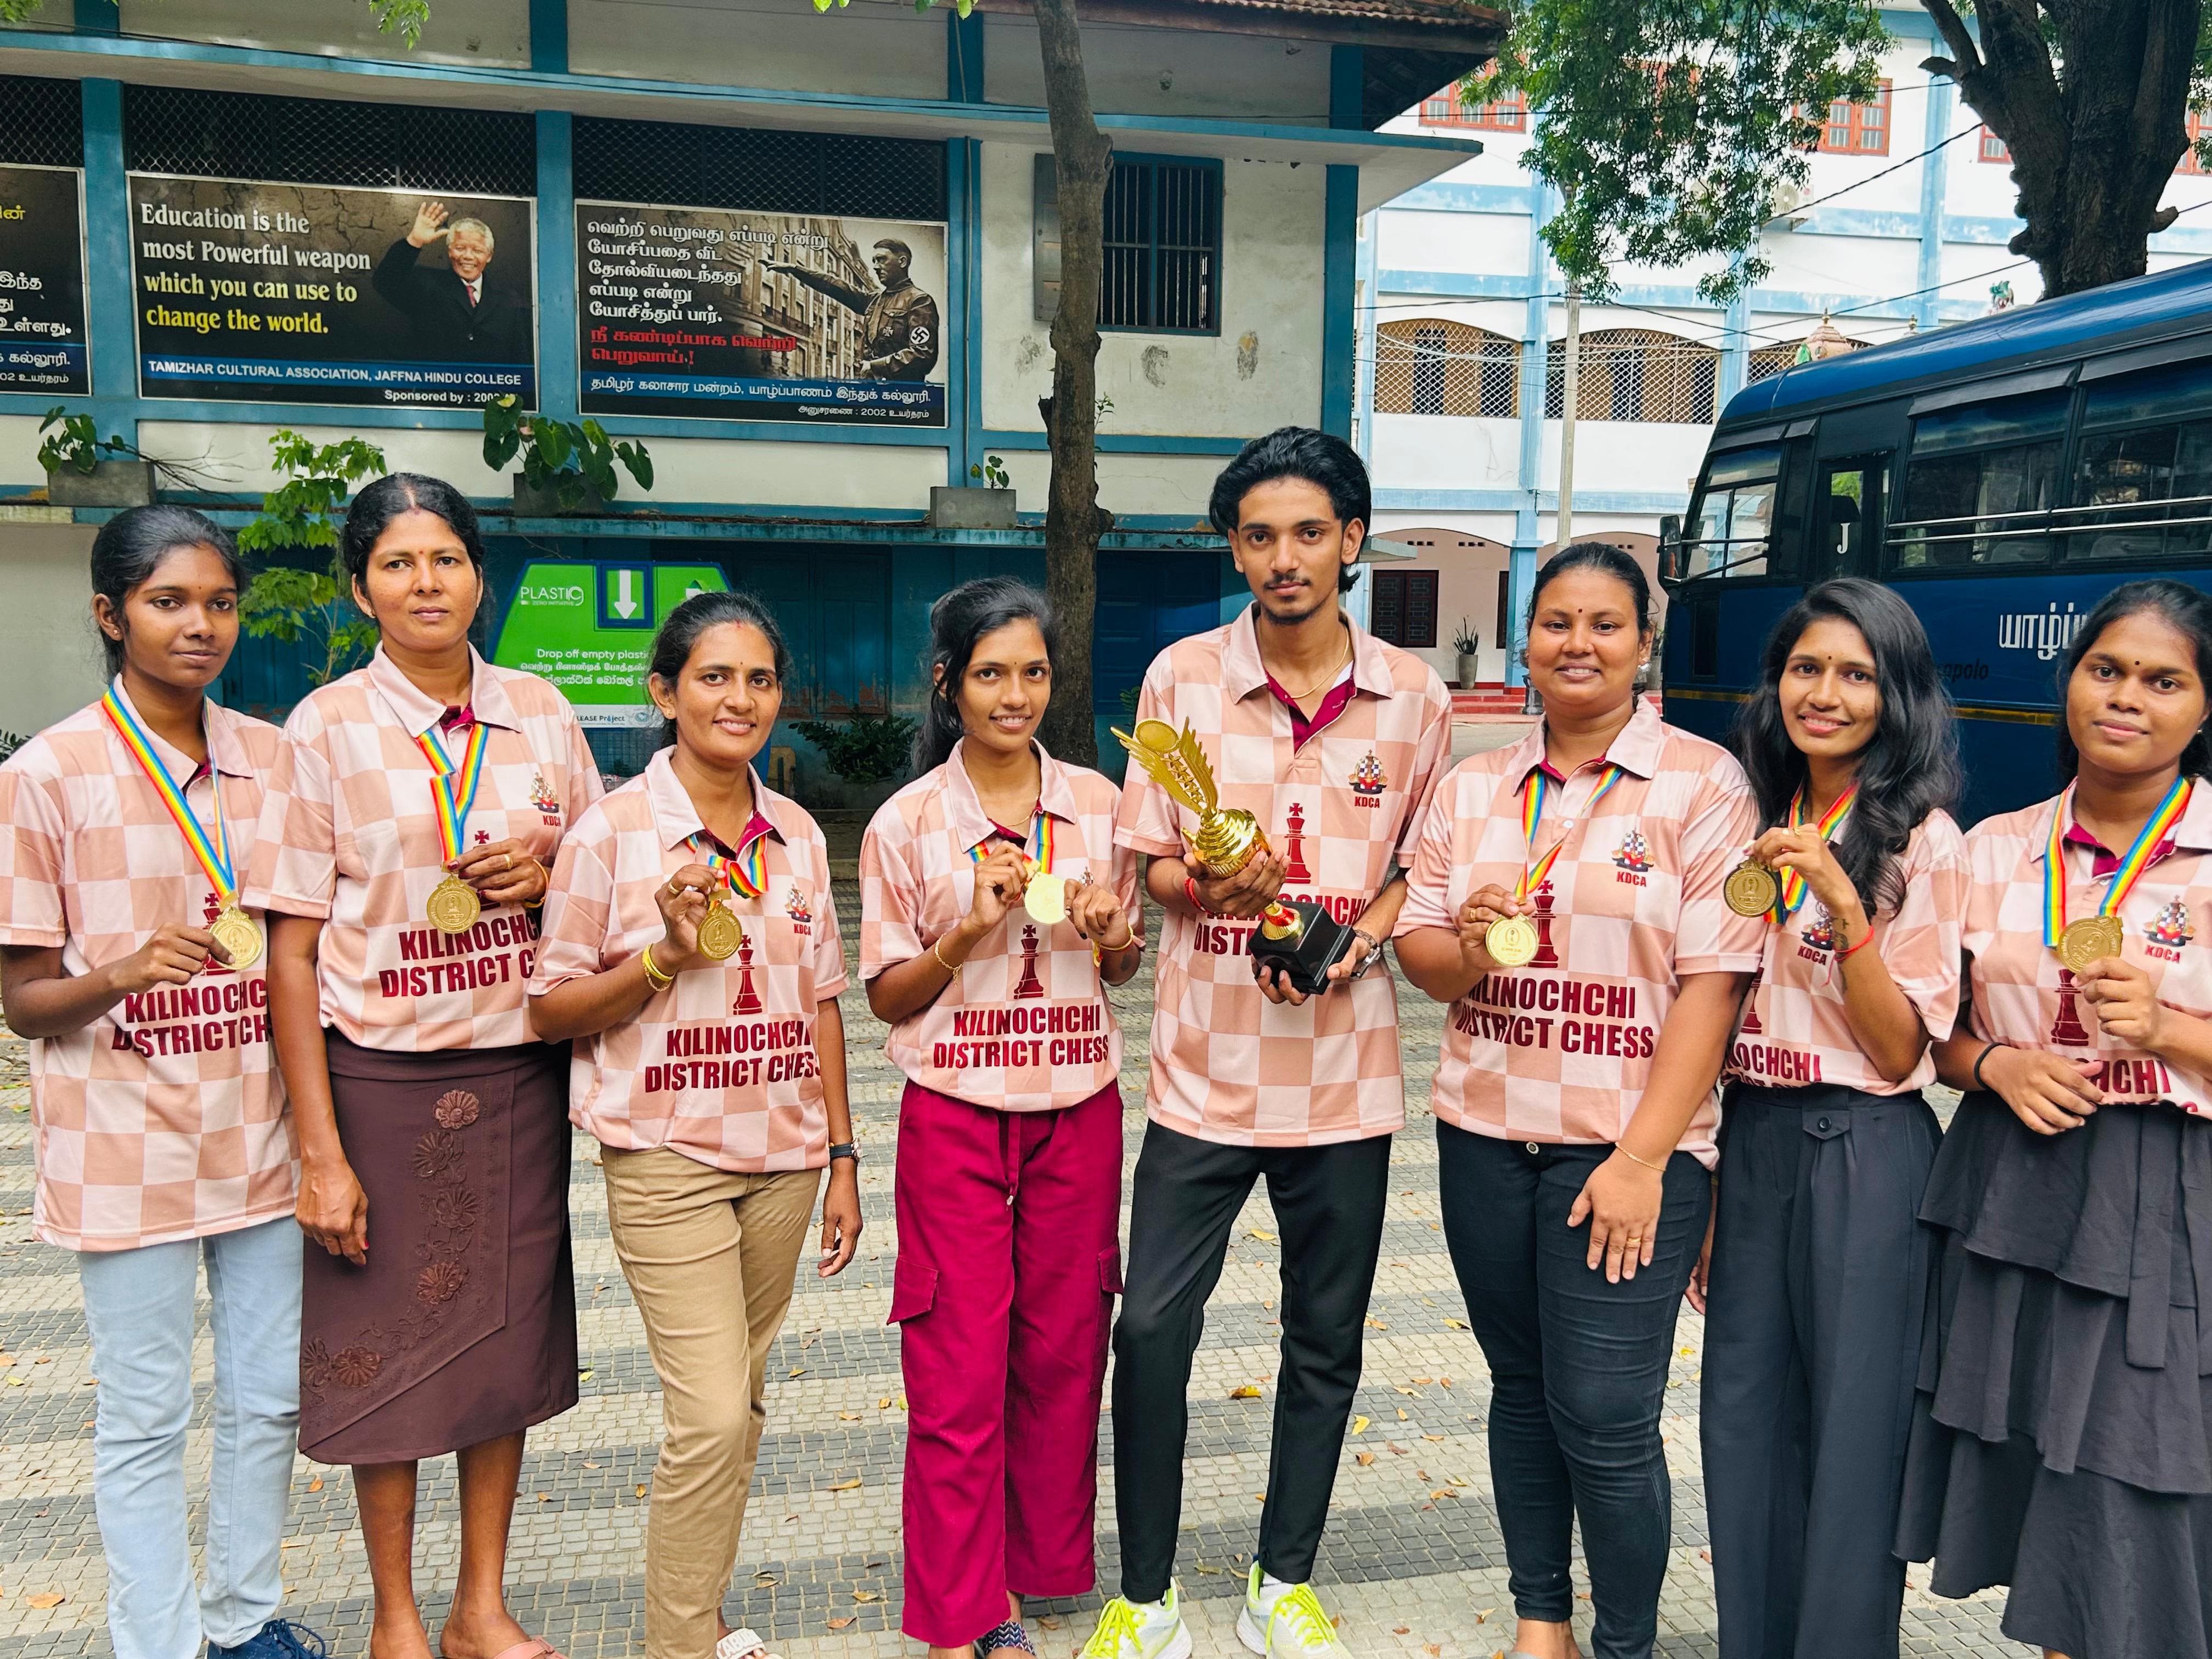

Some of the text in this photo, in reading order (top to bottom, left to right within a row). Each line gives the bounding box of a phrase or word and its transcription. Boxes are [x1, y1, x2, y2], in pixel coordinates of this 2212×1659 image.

[140, 203, 309, 234] Education is the
[588, 217, 828, 250] வெற்றி பெறுவது எப்படி என்று
[143, 241, 371, 273] most Powerful weapon
[588, 238, 723, 261] யோசிப்பதை விட
[588, 259, 742, 286] தோல்வியடைந்தது
[144, 272, 358, 302] which you can use to
[589, 279, 692, 304] எப்படி என்று
[146, 305, 329, 334] change the world.
[589, 301, 723, 325] யோசித்துப் பார்.
[590, 326, 797, 352] நீ கண்டிப்பாக வெற்றி
[9, 351, 70, 368] கல்லூரி.
[0, 373, 15, 381] 02
[149, 361, 521, 385] TAMIZHAR CULTURAL ASSOCIATION, JAFFNA HINDU COLLEGE
[384, 390, 447, 402] Sponsored
[450, 391, 464, 404] by
[591, 376, 634, 392] தமிழர்
[639, 380, 690, 394] கலாசார
[749, 384, 833, 399] யாழ்ப்பாணம்
[836, 386, 878, 402] இந்துக்
[861, 408, 887, 416] 2002
[1837, 522, 1850, 554] J
[521, 586, 584, 606] PLASTIC
[537, 648, 646, 661] Drop off empty plasti
[1354, 796, 1380, 809] KDCA
[1616, 871, 1646, 887] KDCA
[794, 923, 812, 936] KDCA
[1797, 945, 1827, 966] KDCA
[2144, 944, 2181, 963] KDCA
[379, 953, 512, 997] DISTRICT
[126, 979, 267, 1024] KILINOCHC
[953, 1005, 1101, 1036] KILINOCHCHI
[1455, 1001, 1654, 1058] DISTRICT CHESS
[933, 1035, 1109, 1069] DISTRICT CHESS
[645, 1057, 762, 1093] DISTRICT
